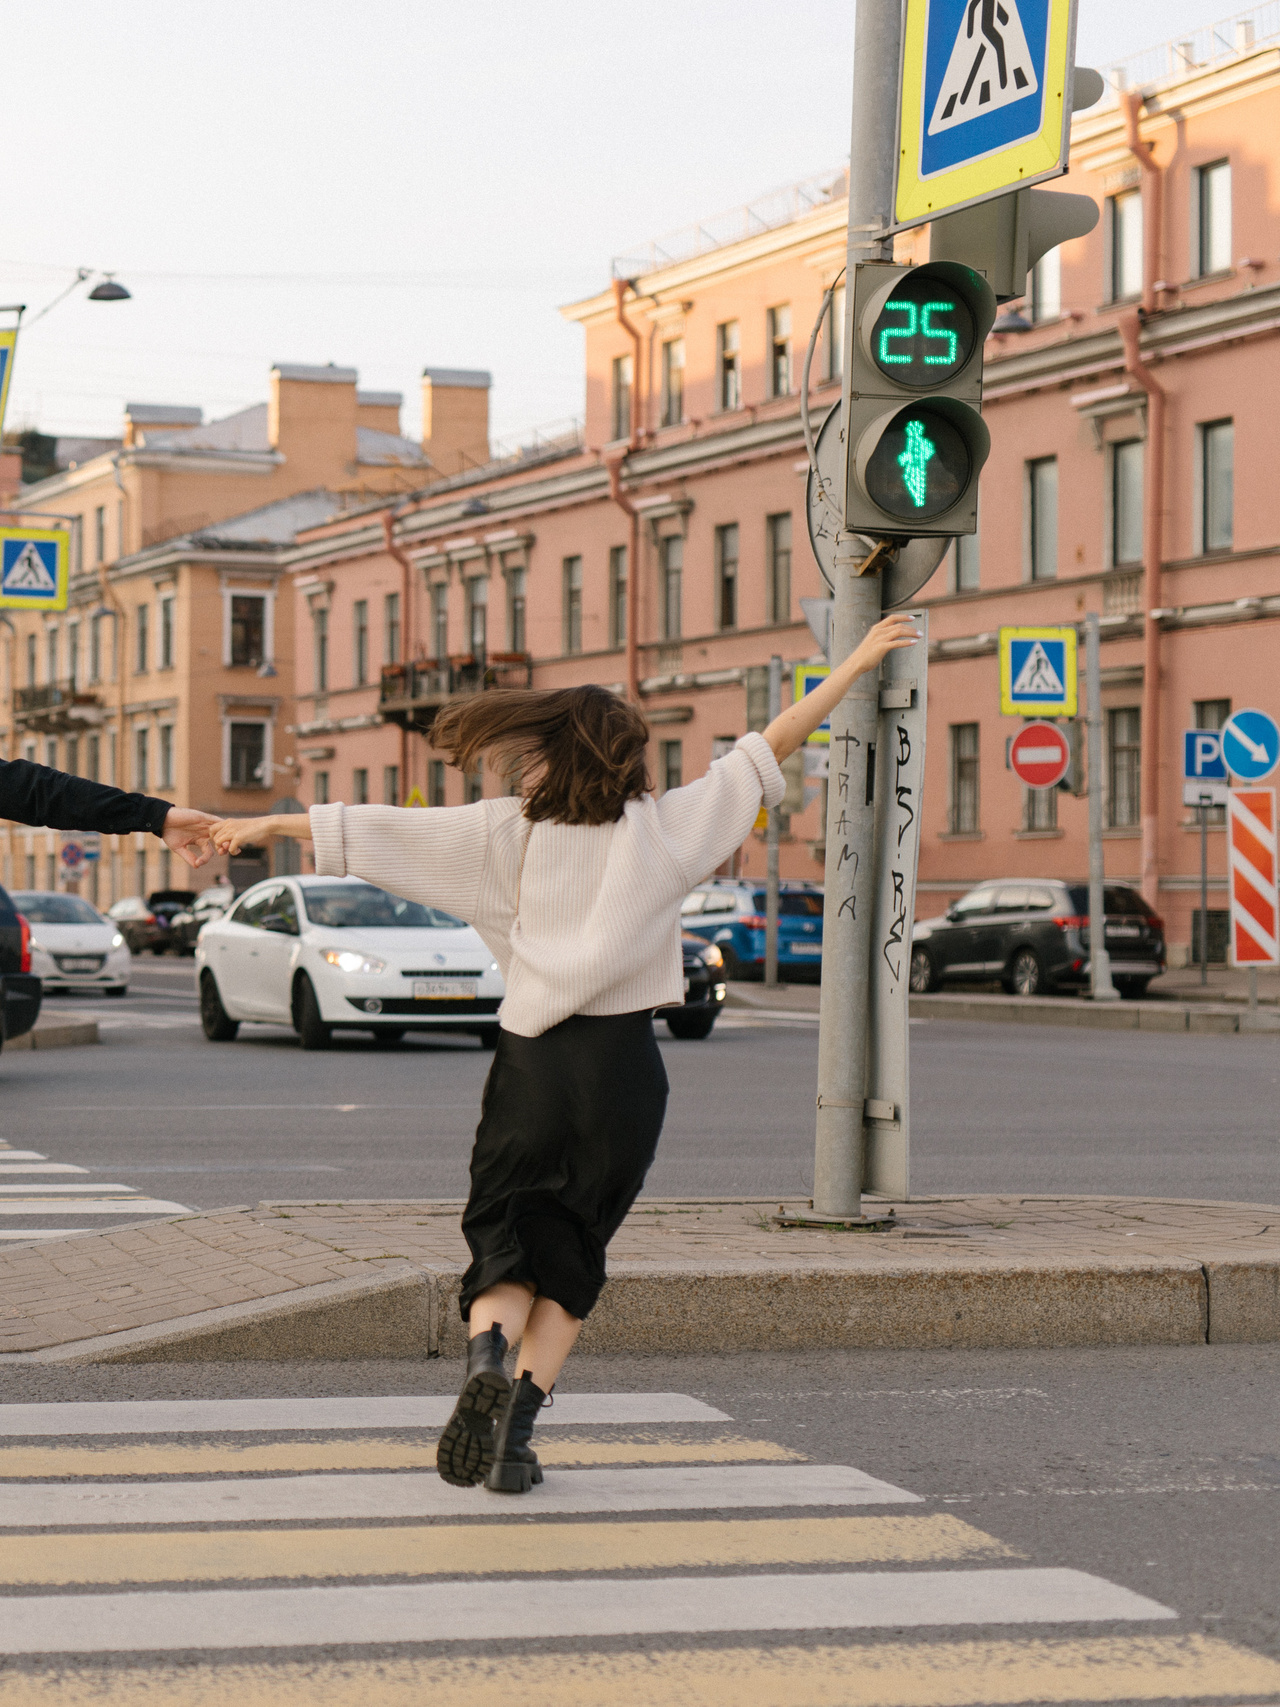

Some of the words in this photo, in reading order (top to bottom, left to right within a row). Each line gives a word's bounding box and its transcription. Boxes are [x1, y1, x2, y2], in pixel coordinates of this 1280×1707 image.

[880, 301, 957, 365] 25
[1195, 735, 1220, 775] P
[834, 728, 861, 921] TRAMA
